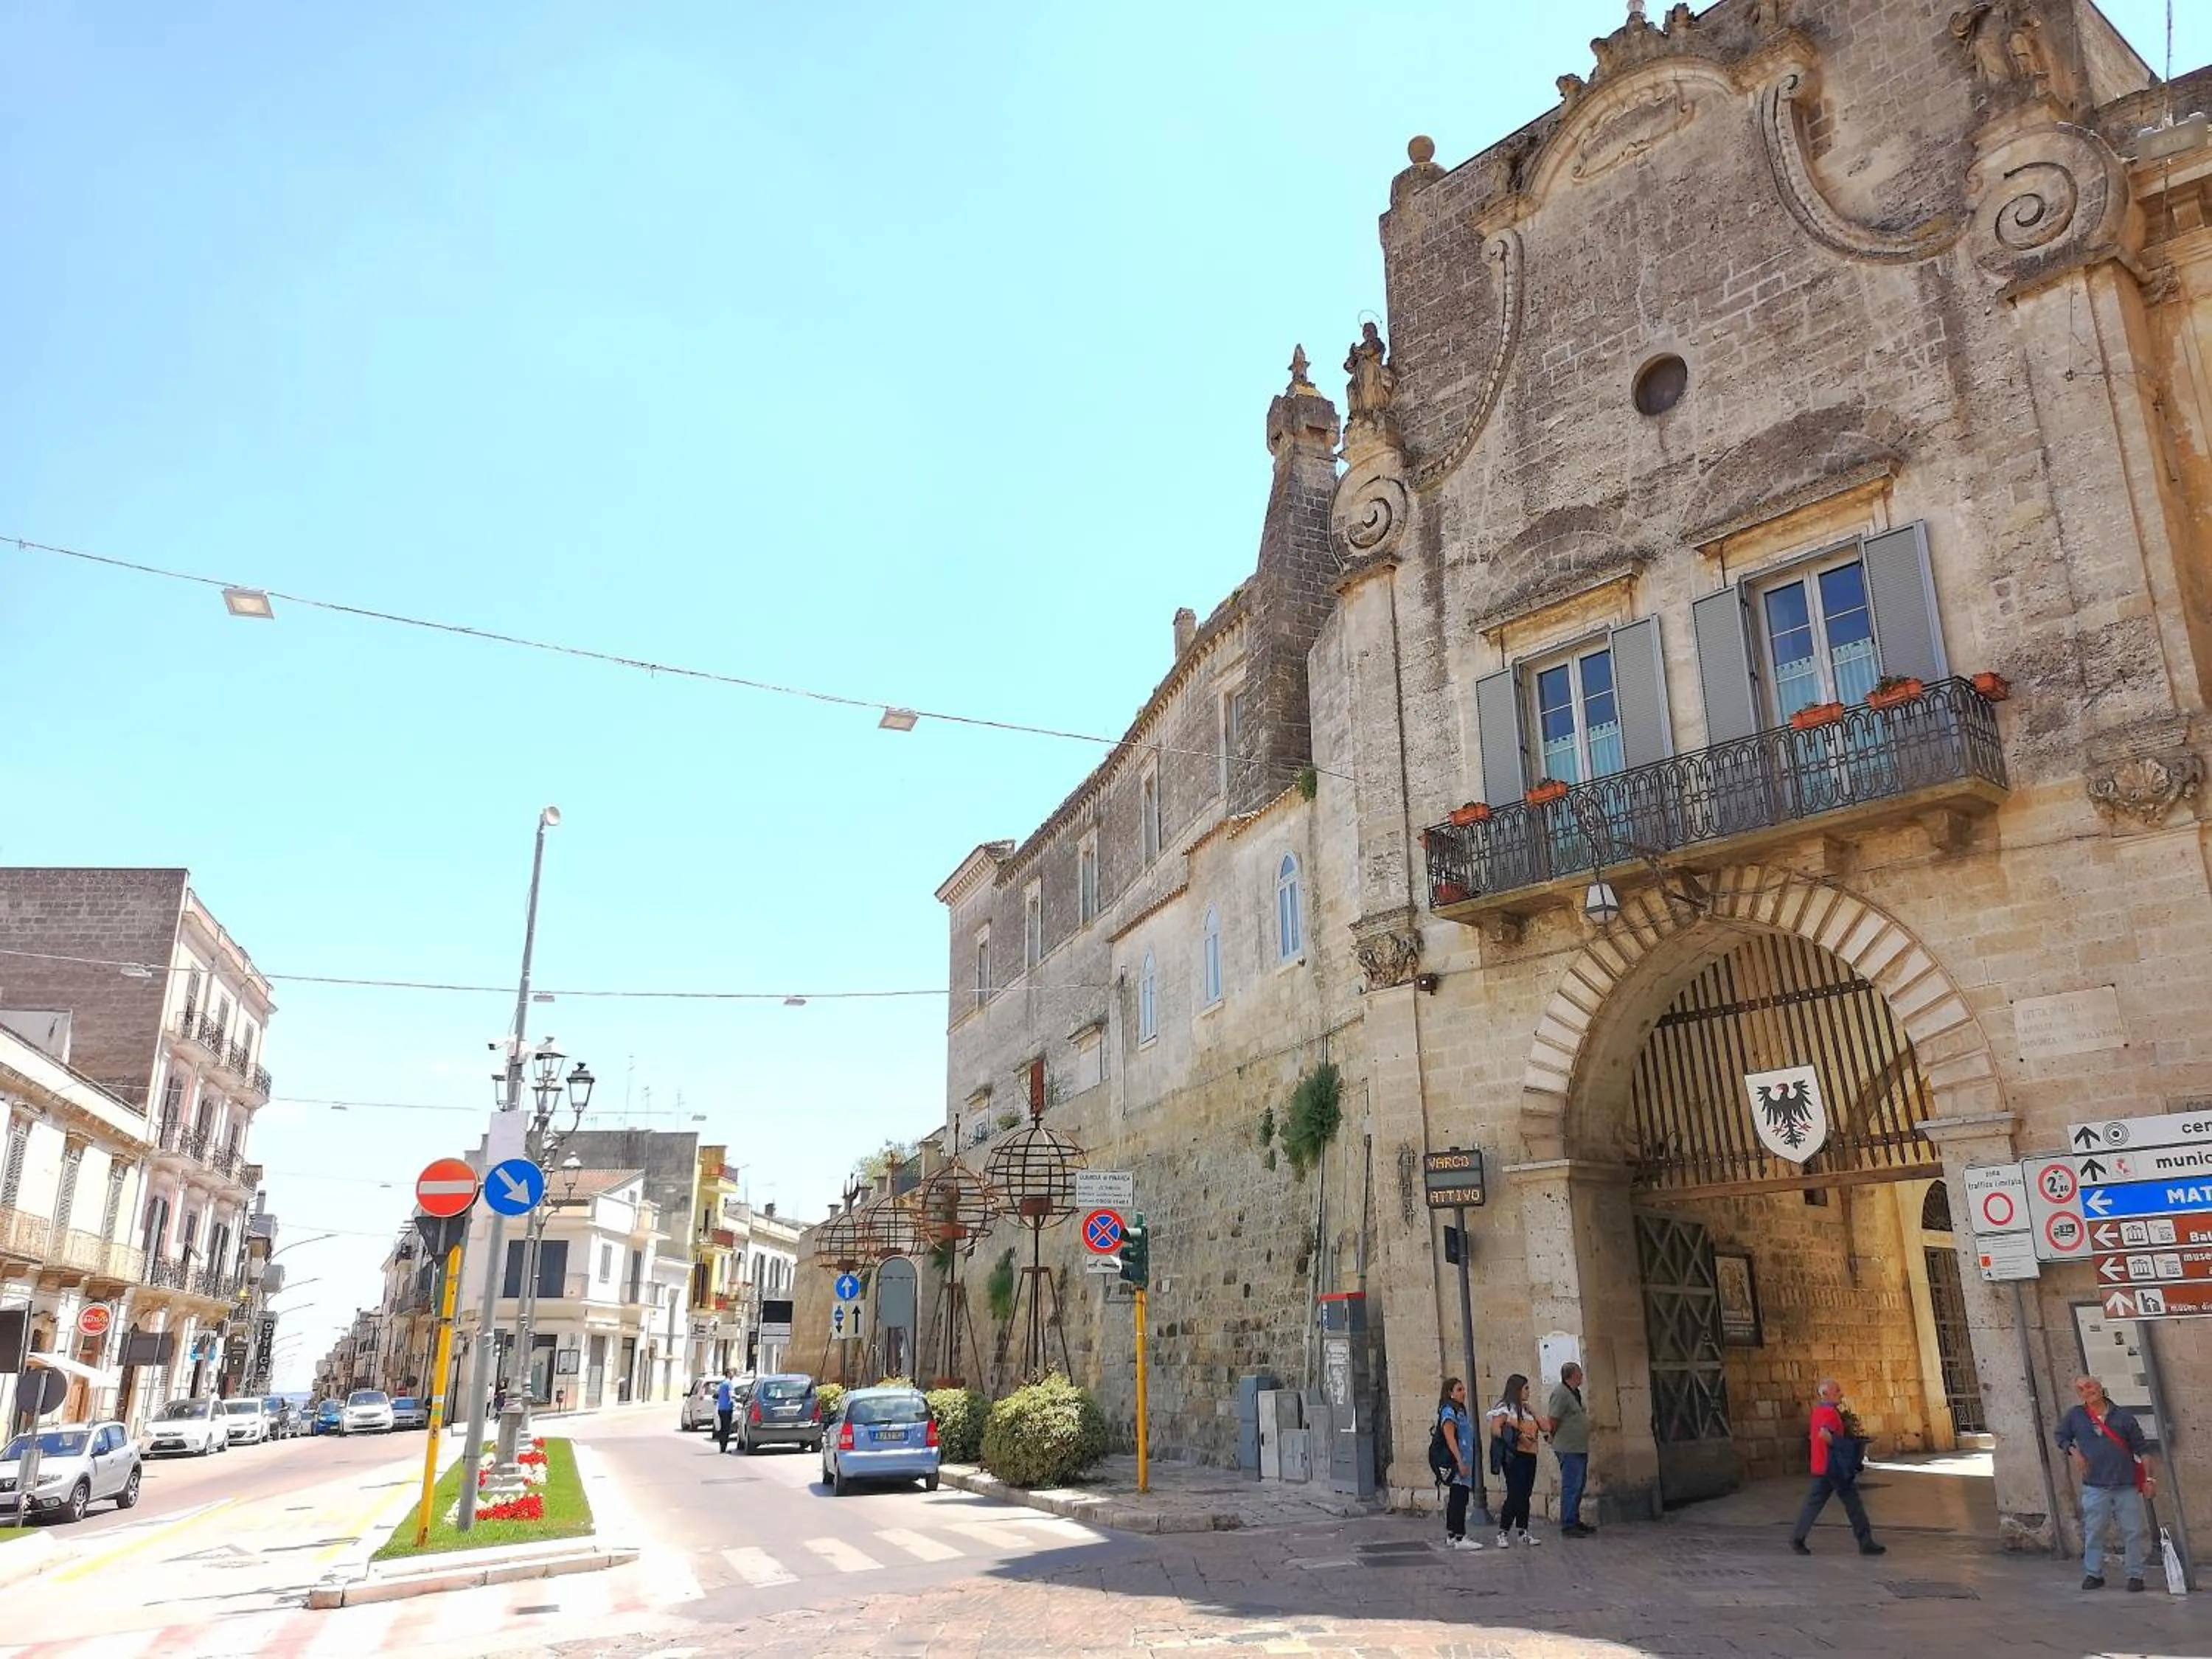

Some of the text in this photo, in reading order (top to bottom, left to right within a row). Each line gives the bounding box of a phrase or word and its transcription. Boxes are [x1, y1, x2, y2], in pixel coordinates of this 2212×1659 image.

[1427, 1155, 1470, 1170] VARCO
[1430, 1189, 1480, 1203] ATTIVO
[258, 1322, 274, 1373] OTTICA
